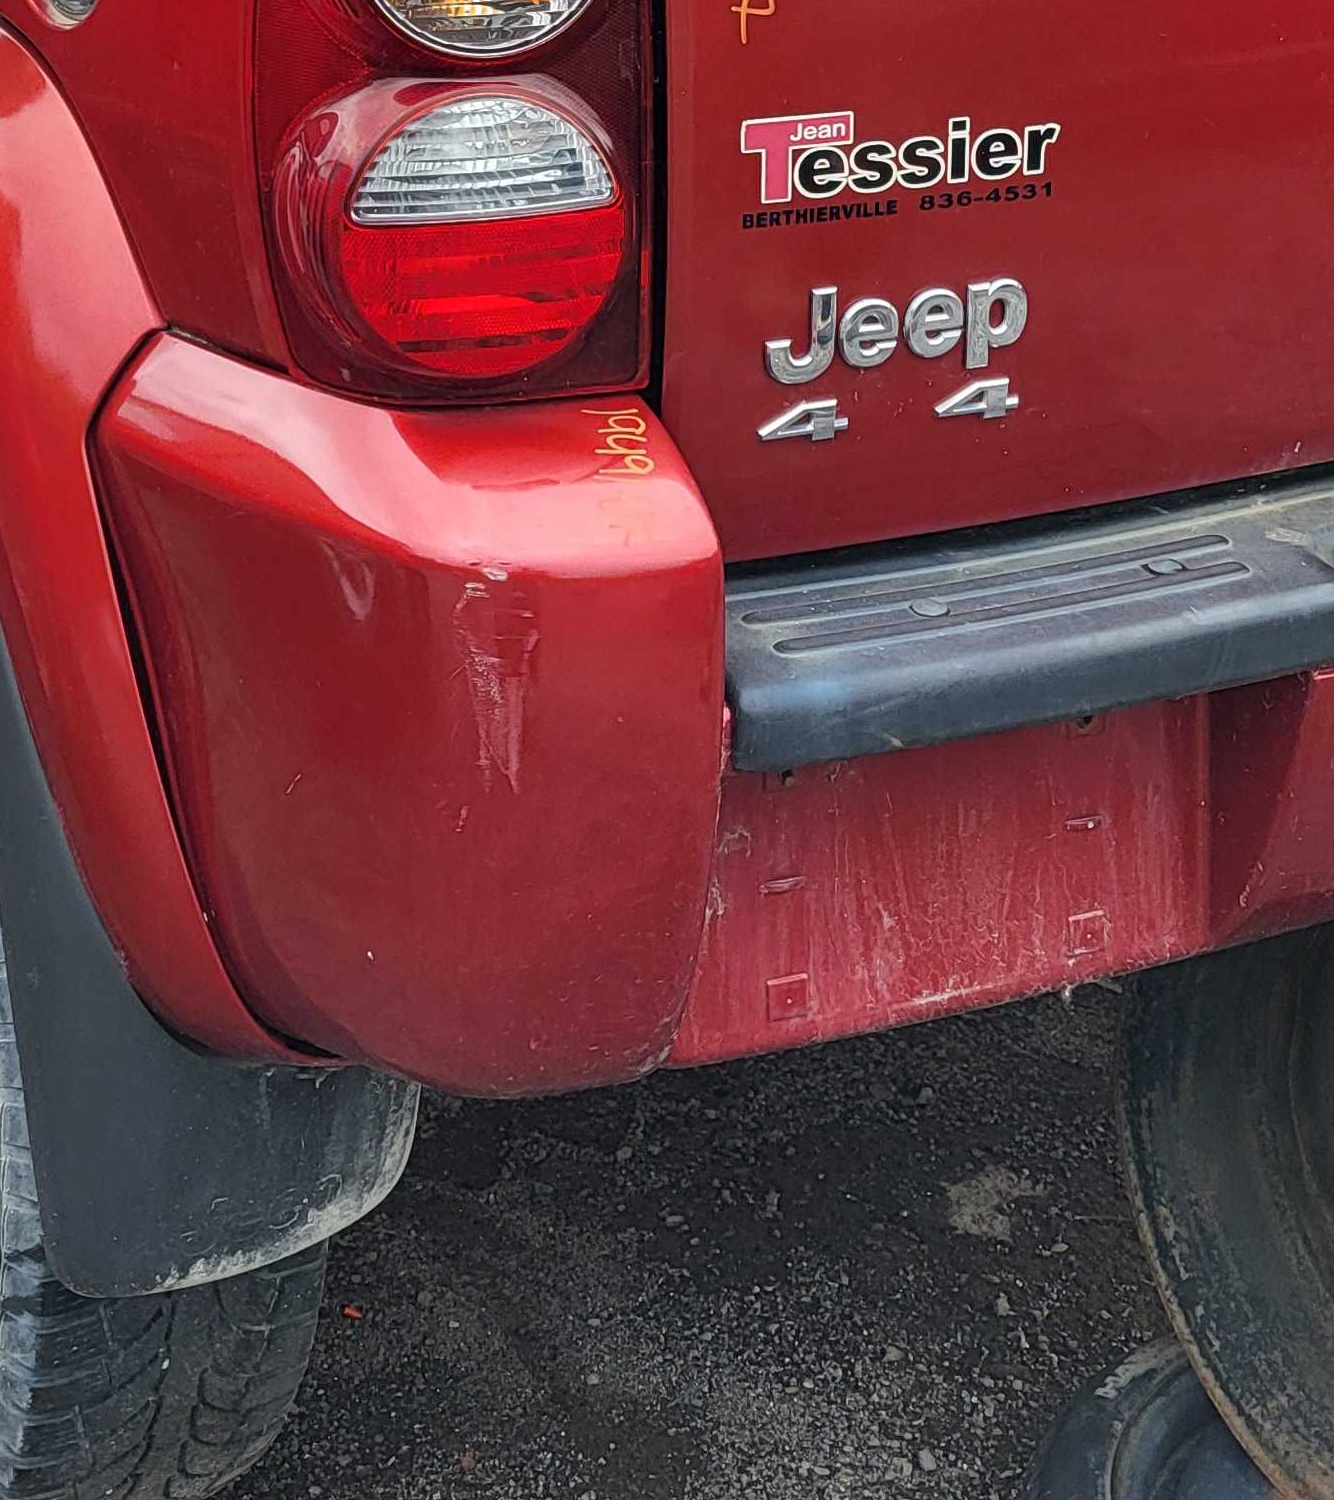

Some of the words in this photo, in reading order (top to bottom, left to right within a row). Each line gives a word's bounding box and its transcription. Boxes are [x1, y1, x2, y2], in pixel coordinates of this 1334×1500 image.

[740, 111, 1061, 204] Tessier
[789, 121, 847, 143] Jean
[741, 199, 899, 229] BERTHIERVILLE
[918, 181, 1054, 212] 836-4531
[763, 277, 1029, 385] Jeep
